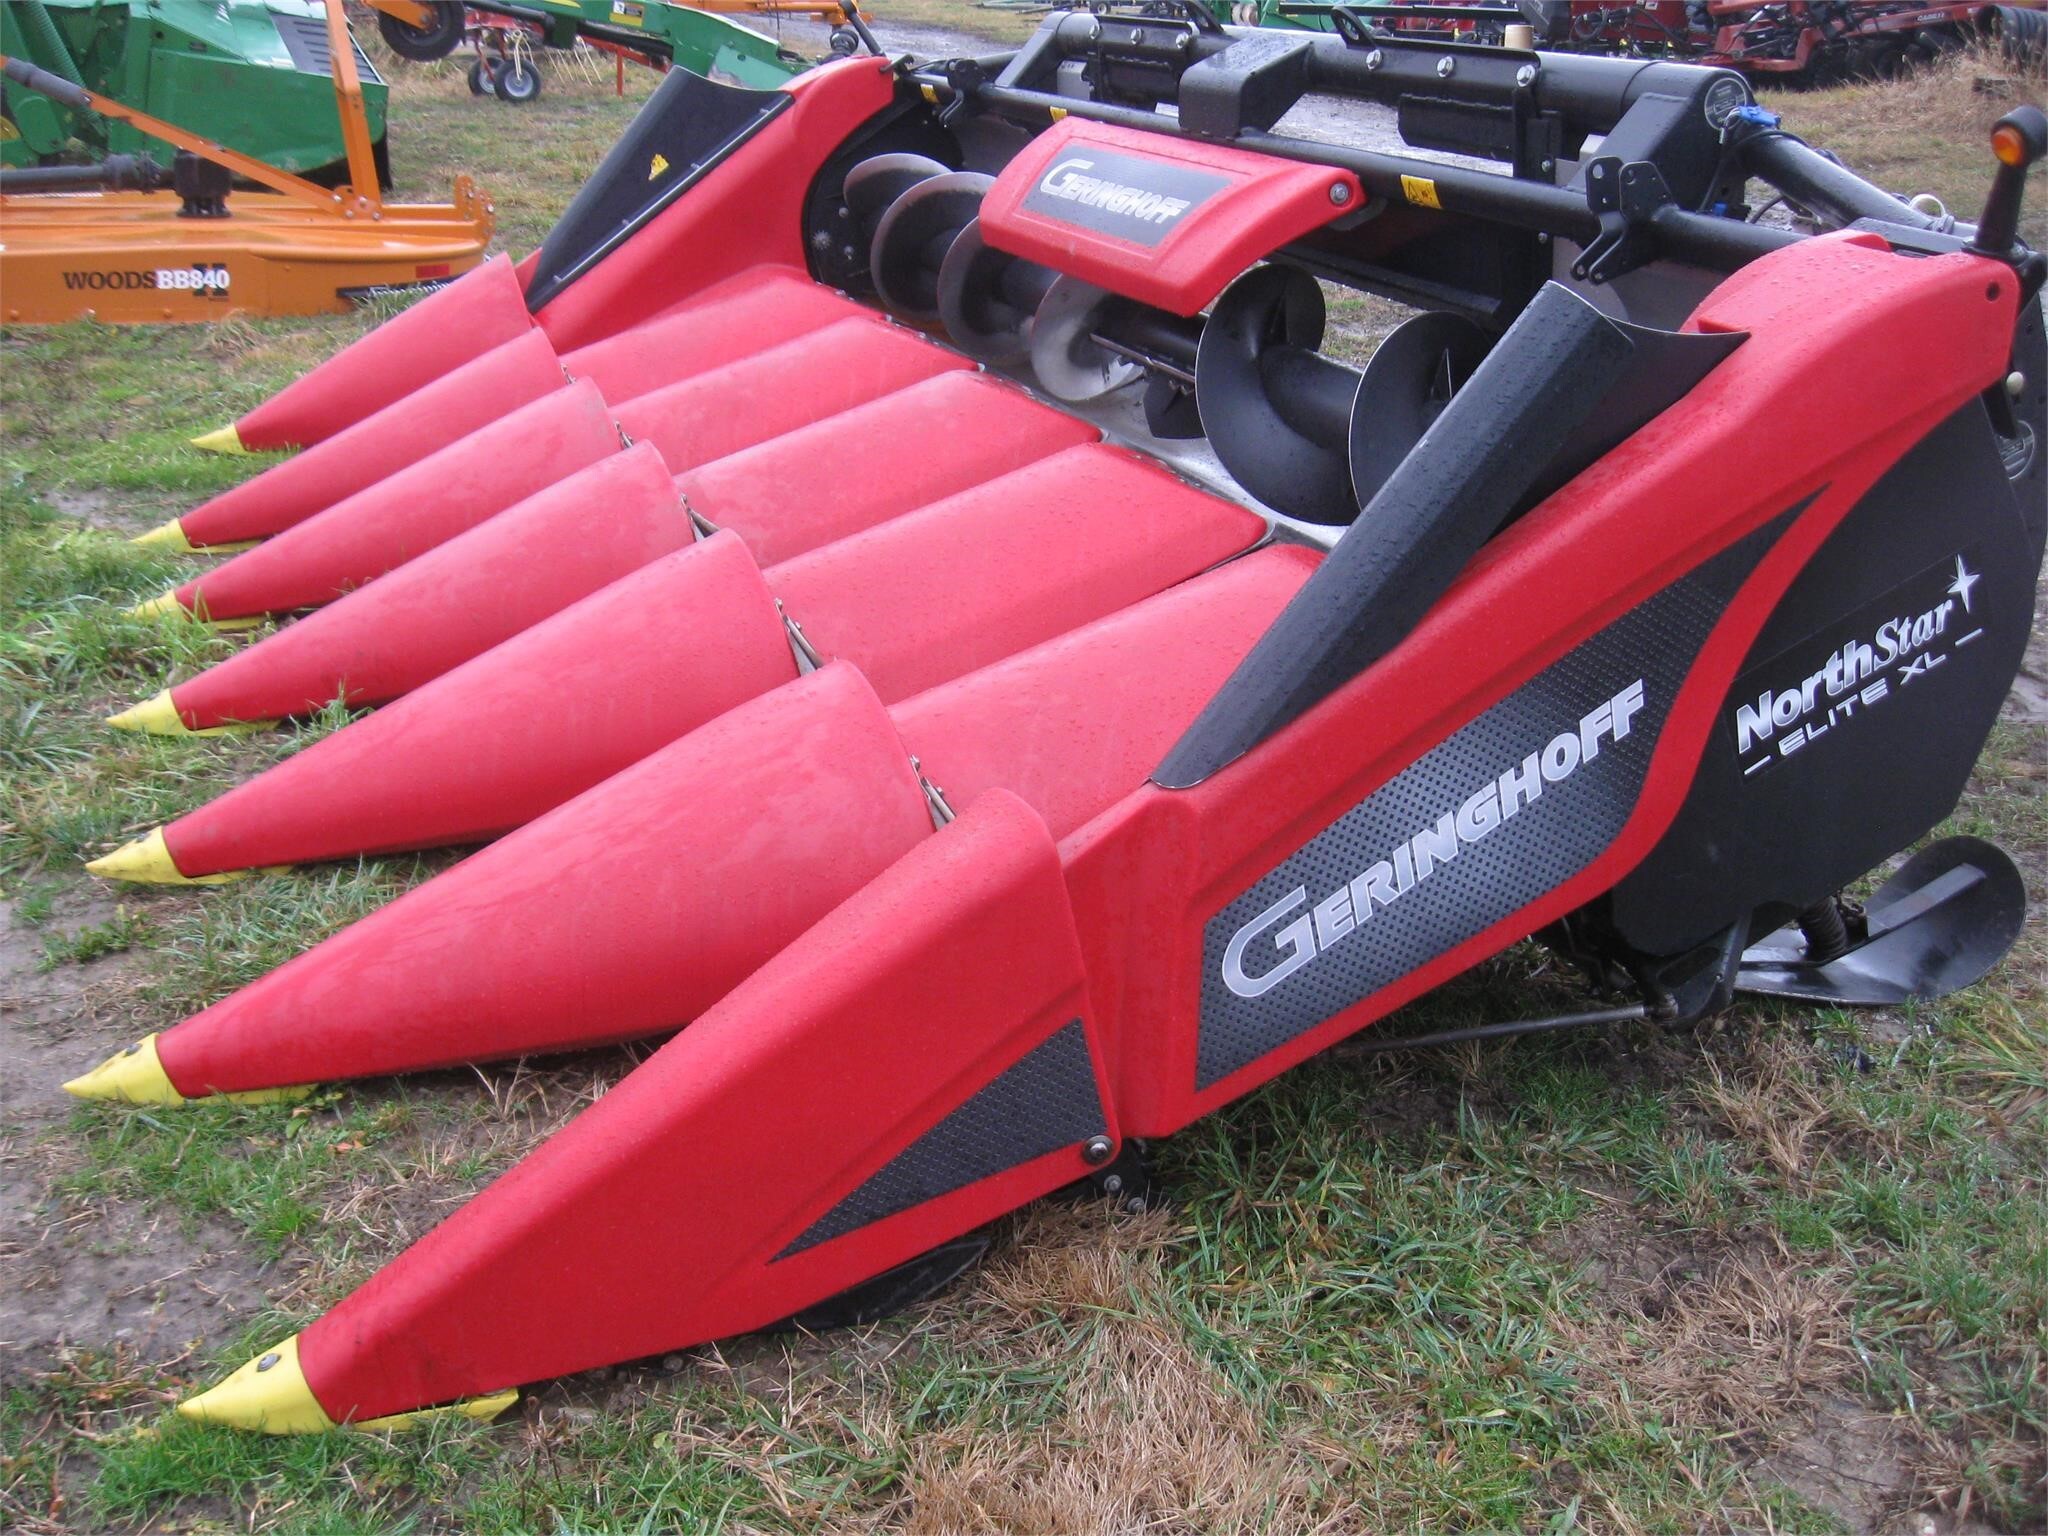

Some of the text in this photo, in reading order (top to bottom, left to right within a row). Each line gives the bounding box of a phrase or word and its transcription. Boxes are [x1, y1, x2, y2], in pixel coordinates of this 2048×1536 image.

[1040, 158, 1191, 224] GERINGHOFF
[63, 271, 157, 290] WOODS
[156, 268, 230, 290] BB840
[1736, 599, 1953, 754] NorthStar
[1778, 651, 1947, 756] ELITE XL
[1221, 678, 1645, 998] GERINGHOFF
